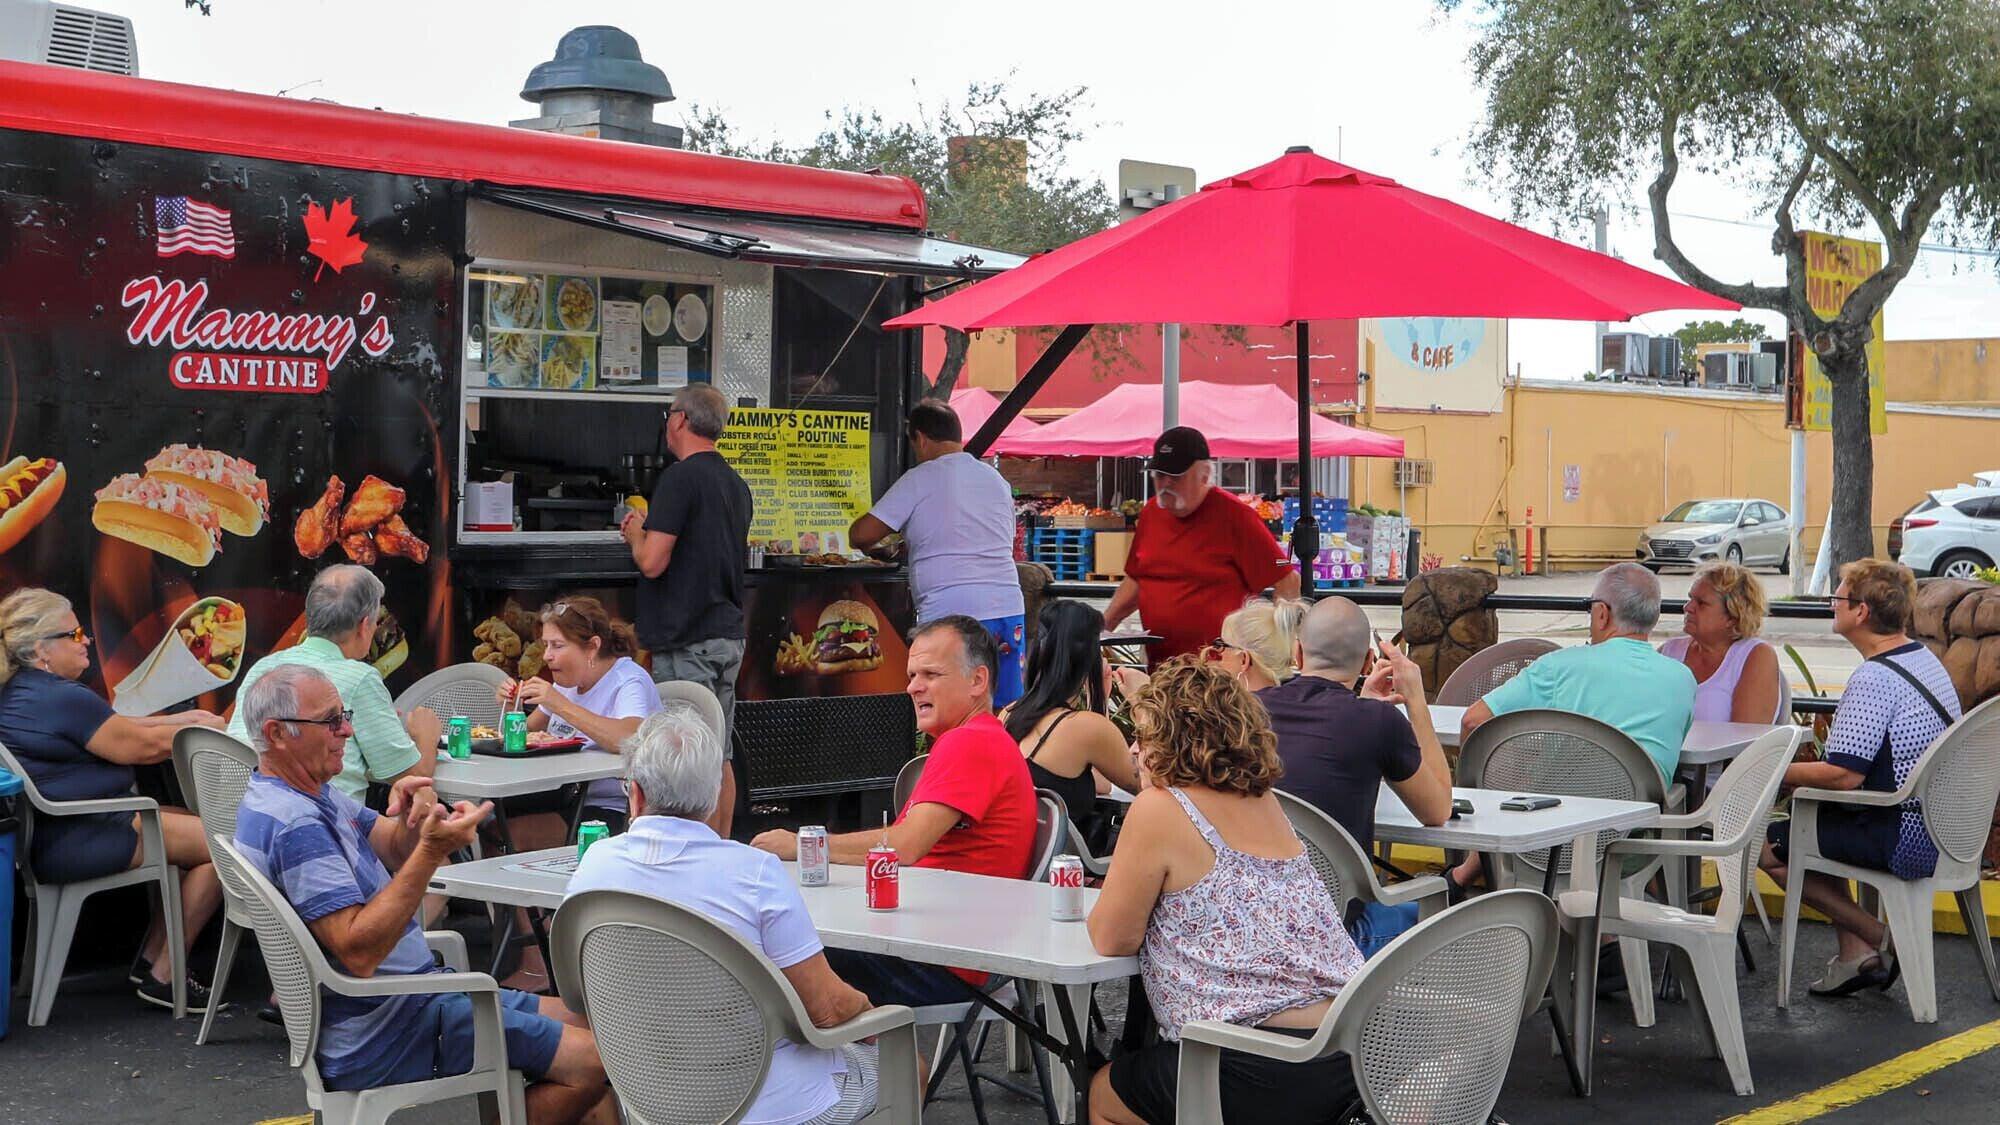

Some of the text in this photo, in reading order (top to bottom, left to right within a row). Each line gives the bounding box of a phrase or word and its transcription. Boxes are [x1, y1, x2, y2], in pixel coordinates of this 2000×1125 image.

[1809, 238, 1878, 278] WORLD
[122, 276, 393, 370] Mammy's
[1411, 342, 1453, 369] & CAFE
[174, 356, 318, 387] CANTINE
[753, 432, 777, 440] ROLLS
[798, 430, 847, 443] POUTINE
[788, 479, 812, 487] CHICKEN
[789, 490, 847, 498] CLUB SANDWICH
[1049, 866, 1083, 888] oke
